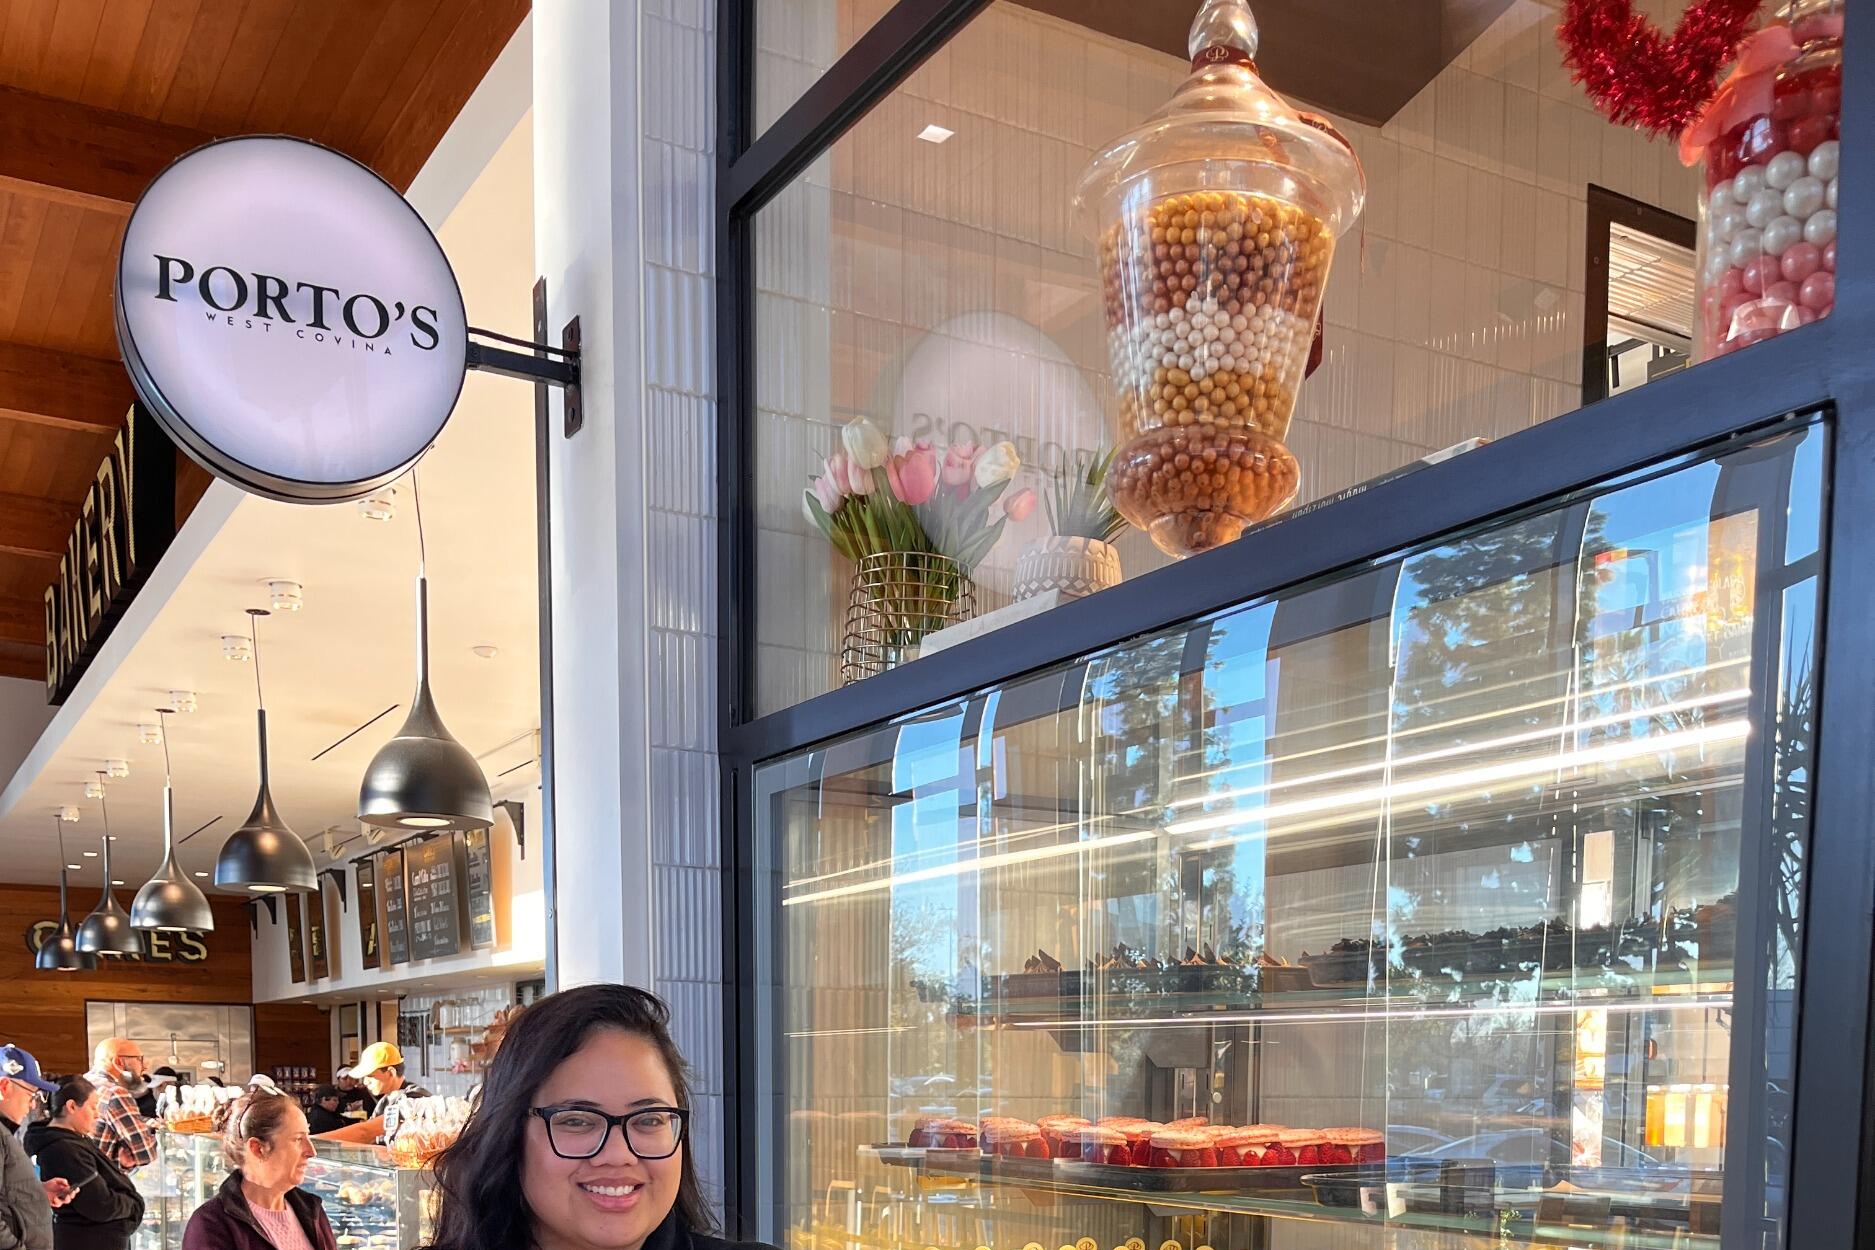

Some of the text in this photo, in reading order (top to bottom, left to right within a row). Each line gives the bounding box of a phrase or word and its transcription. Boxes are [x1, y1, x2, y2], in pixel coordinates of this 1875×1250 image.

[153, 254, 440, 351] PORTO'S
[206, 311, 392, 356] WEST COVINA
[44, 403, 136, 690] BAKERY
